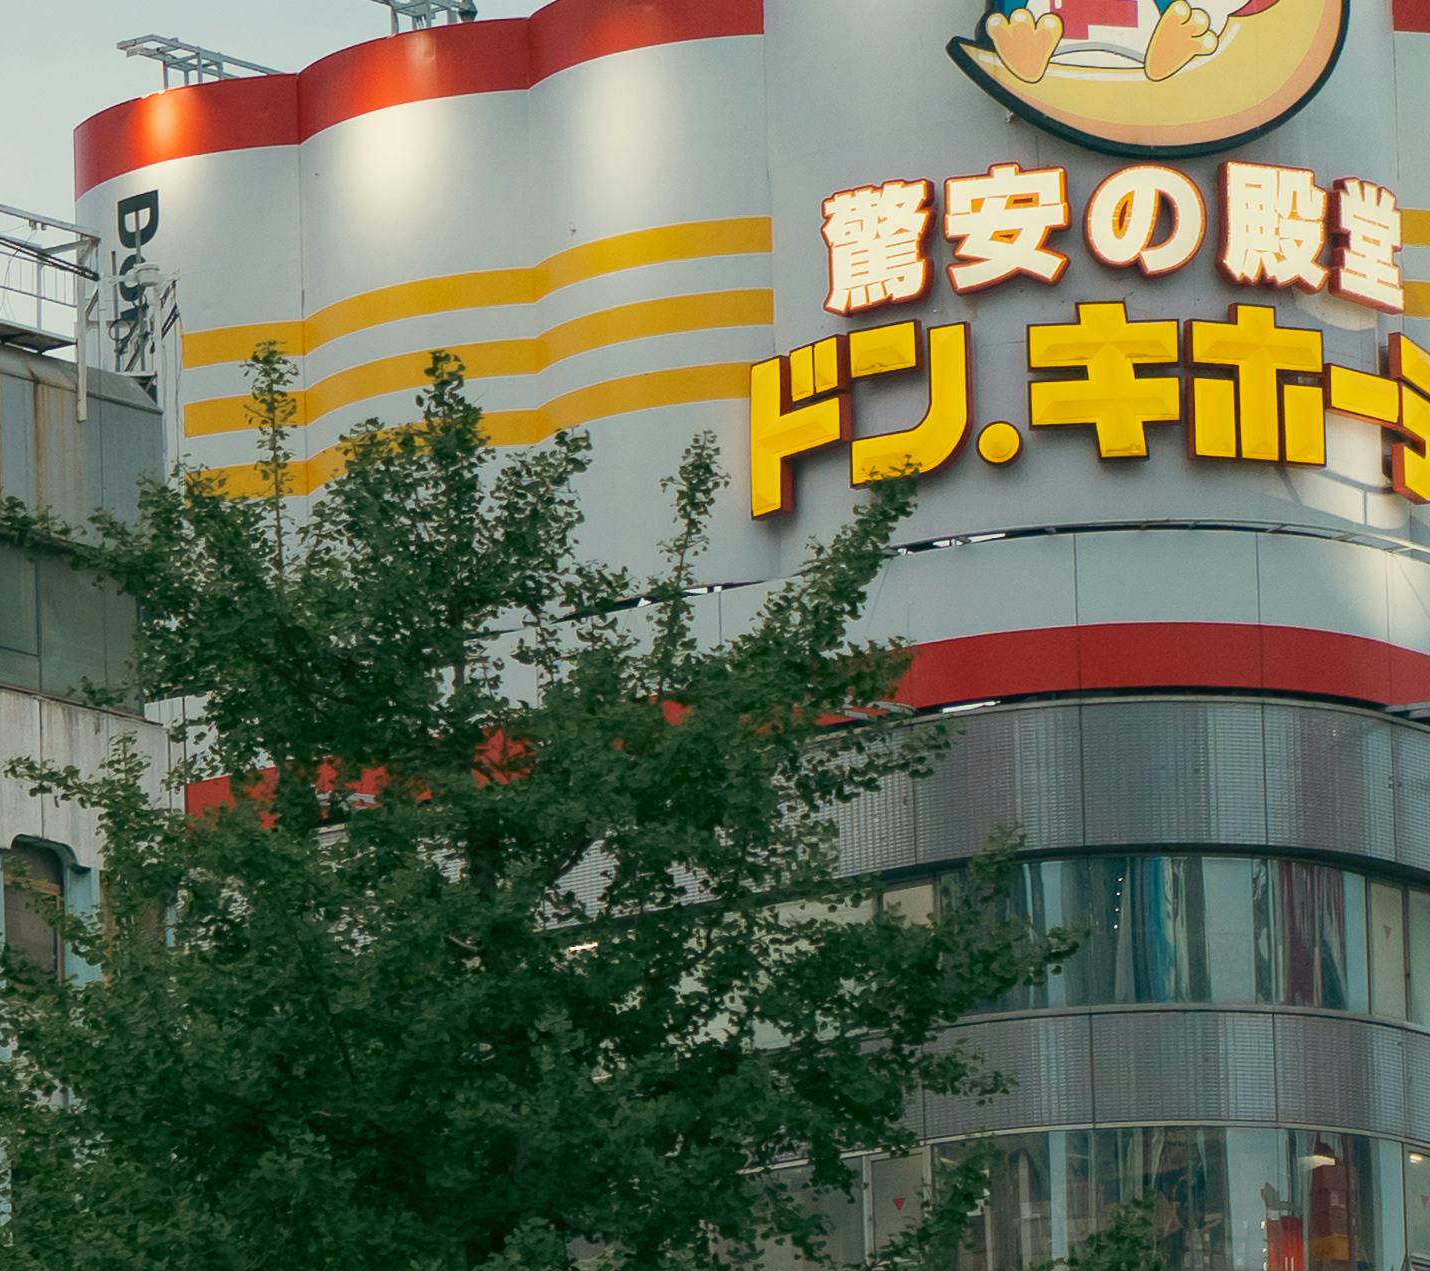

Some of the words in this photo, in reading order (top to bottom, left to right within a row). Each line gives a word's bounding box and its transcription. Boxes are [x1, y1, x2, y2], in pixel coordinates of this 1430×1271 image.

[821, 160, 1404, 317] 驚安の殿堂
